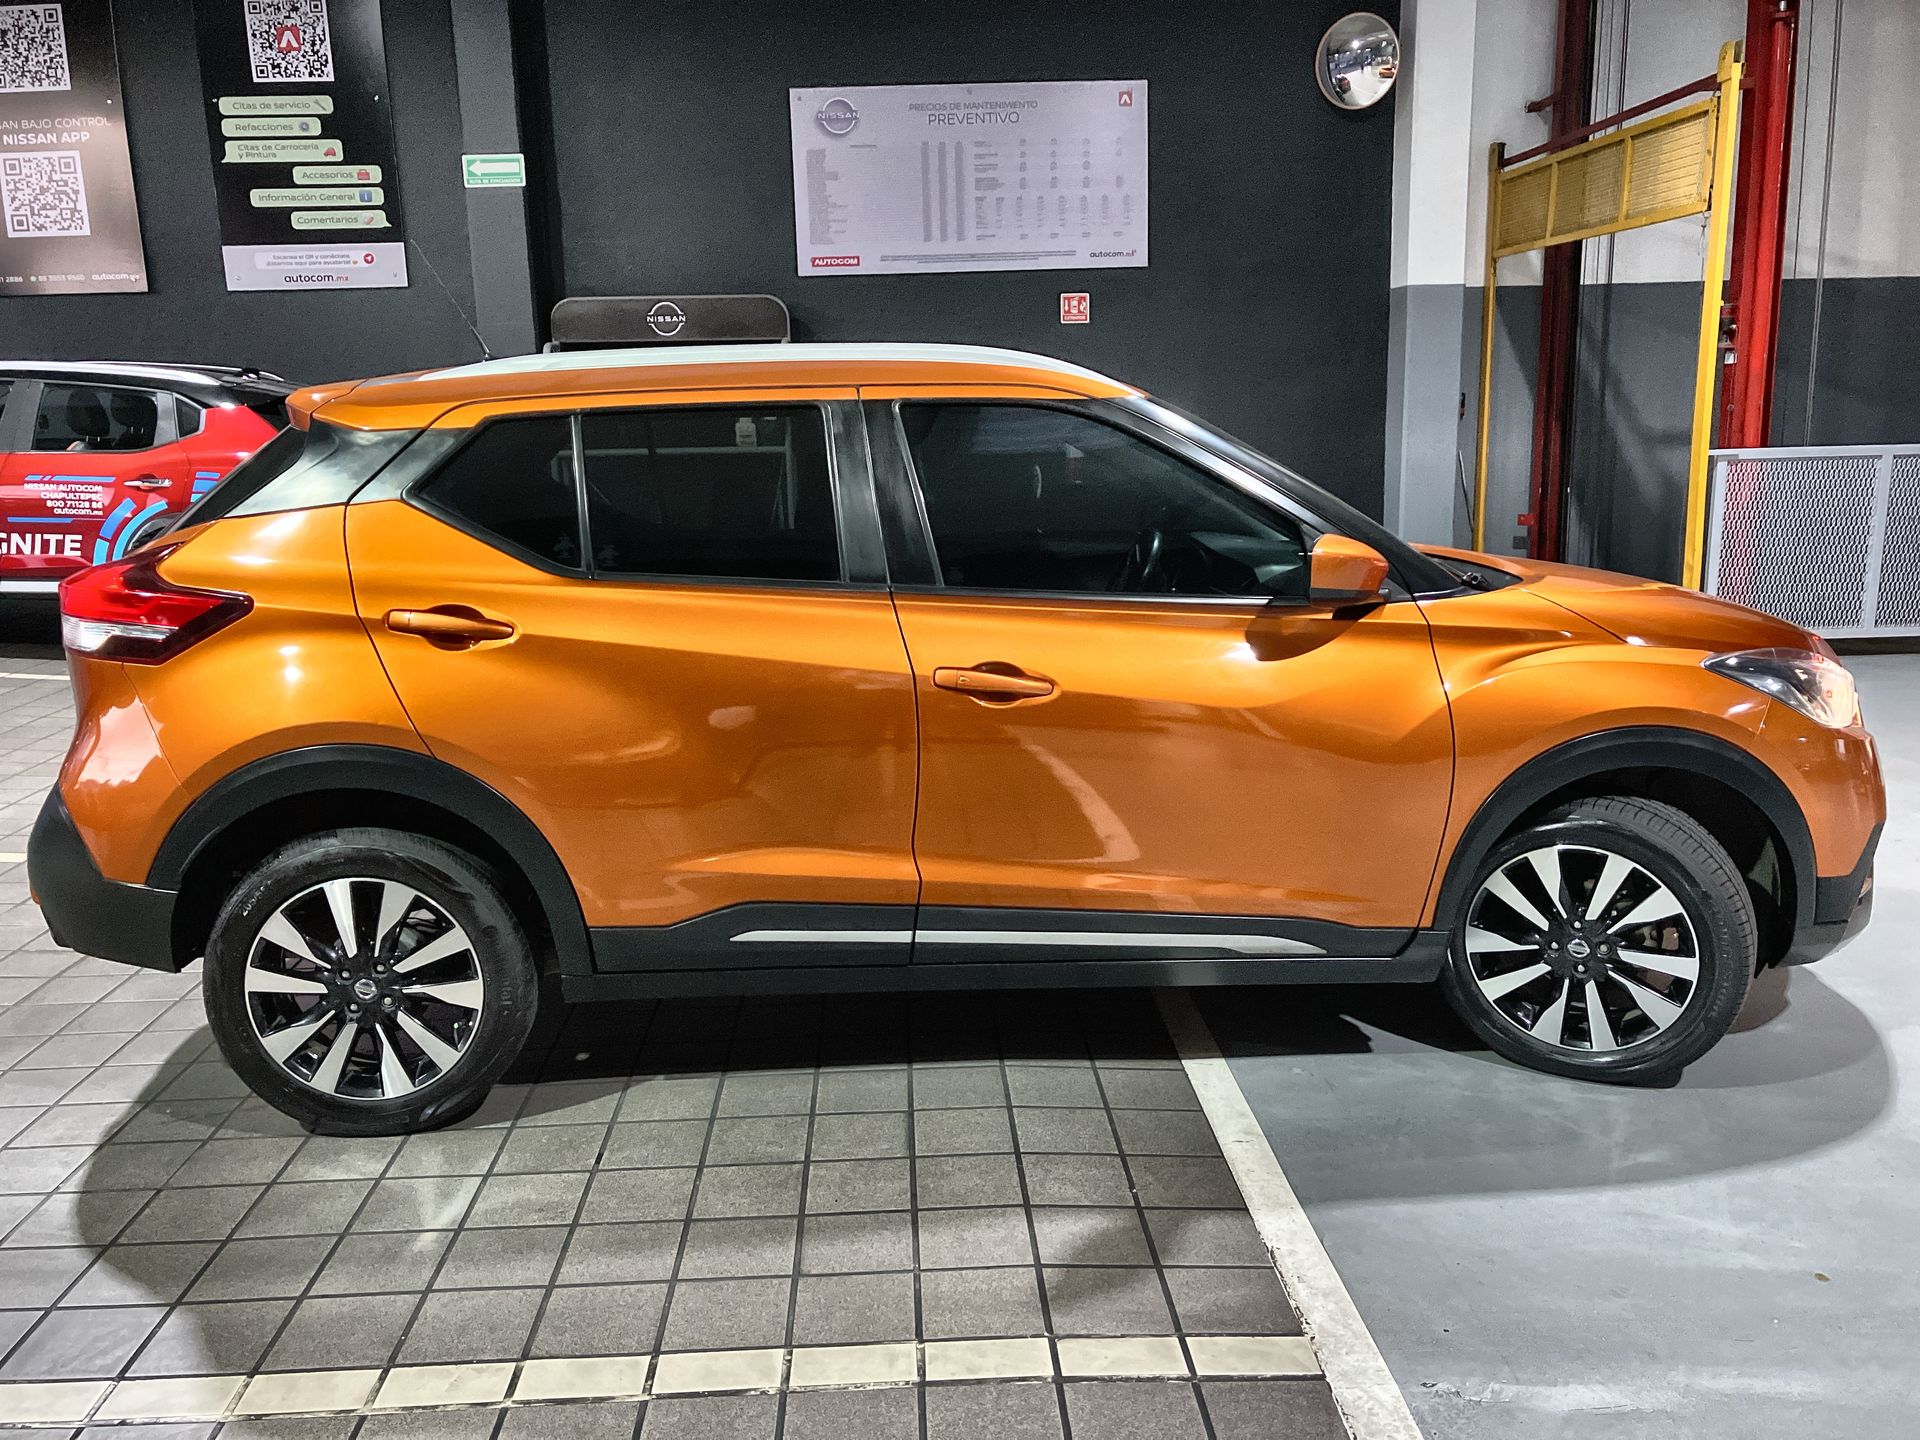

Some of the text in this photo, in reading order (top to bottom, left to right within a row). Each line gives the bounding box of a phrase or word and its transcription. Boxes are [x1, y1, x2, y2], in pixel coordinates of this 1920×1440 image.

[232, 101, 311, 110] Citas de servicio
[949, 102, 961, 111] DE
[963, 100, 1038, 110] MANTENIMIENTO
[817, 111, 860, 119] NISSAN
[928, 111, 1020, 125] PREVENTIVO
[21, 118, 52, 129] BAJO
[54, 116, 112, 128] CONTROL
[235, 123, 293, 131] Refacciones
[3, 131, 90, 145] NISSAN APP
[237, 143, 260, 151] Citas
[261, 143, 273, 151] de
[237, 151, 243, 159] y
[302, 171, 354, 179] Accesorios
[258, 192, 356, 201] Información General
[297, 216, 359, 224] Comentarios
[814, 257, 858, 265] AUTOCOM
[284, 273, 350, 283] autocom.mx
[646, 315, 686, 323] NISSAN
[24, 483, 103, 492] NISSAN AUTOCOM
[40, 491, 103, 500] CHAPULTEPEC
[66, 500, 90, 508] 71128
